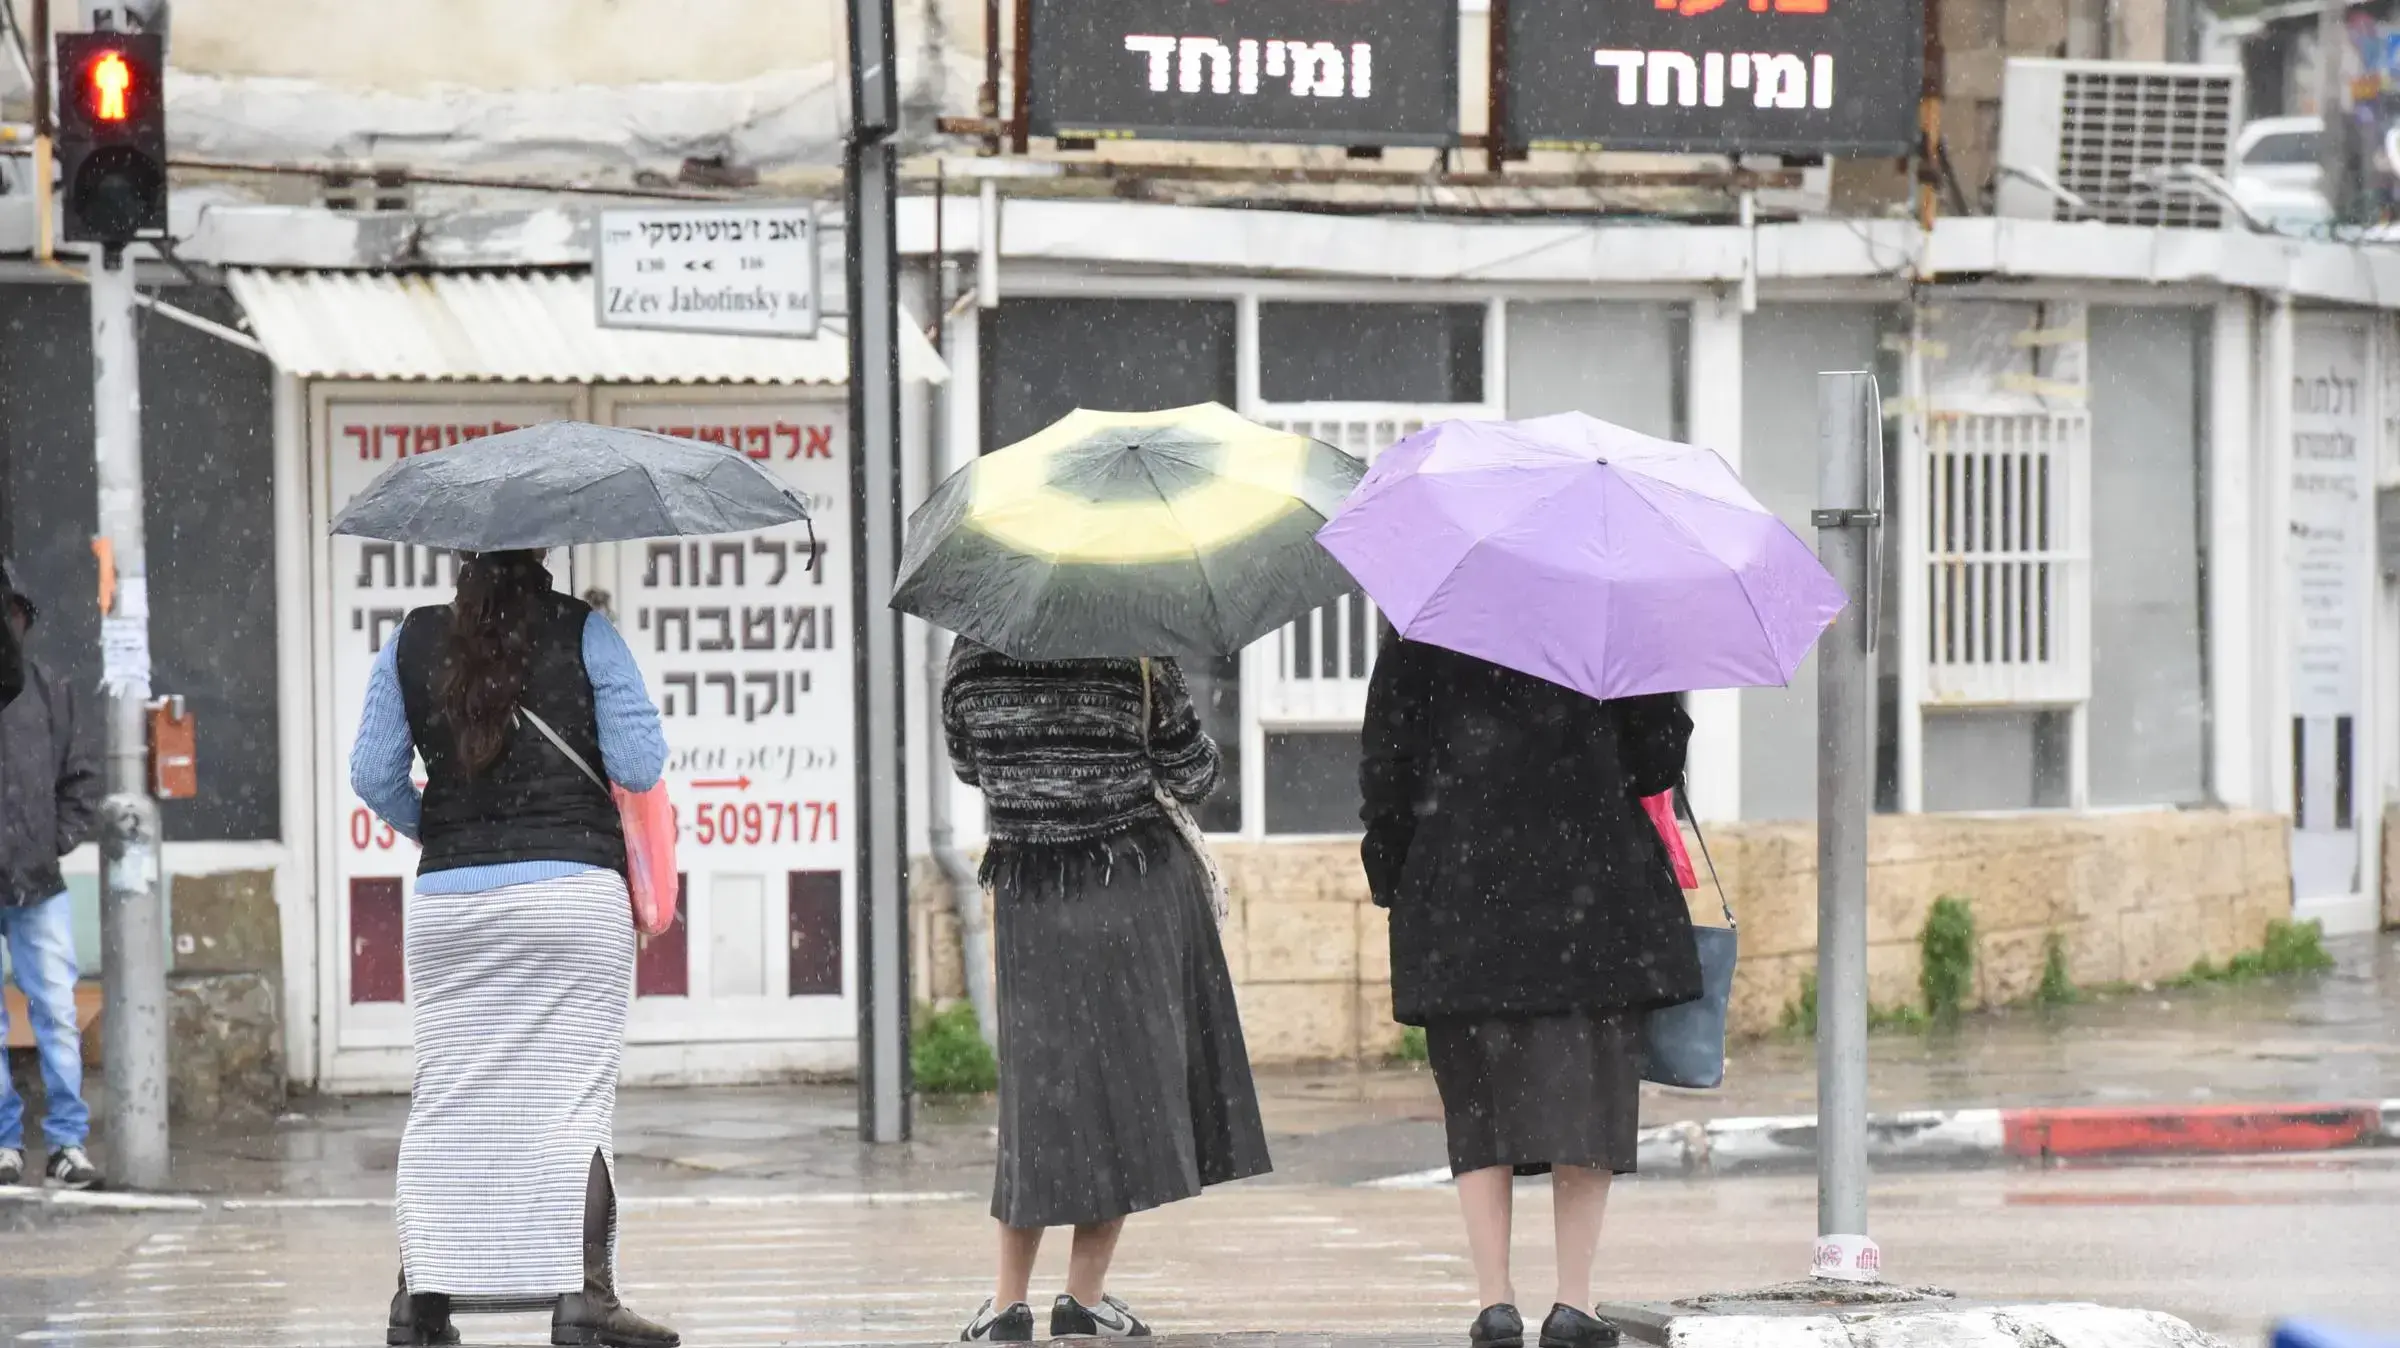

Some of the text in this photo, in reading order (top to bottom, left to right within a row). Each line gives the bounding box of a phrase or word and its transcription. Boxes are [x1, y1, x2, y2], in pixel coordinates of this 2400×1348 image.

[1124, 35, 1372, 98] ומיוחד
[1594, 49, 1834, 109] ומיוחד
[768, 218, 808, 240] זאב
[668, 284, 780, 319] Jabotinsky
[356, 541, 458, 588] תות
[643, 537, 827, 587] דלתות
[638, 604, 834, 652] ומטבחי
[663, 670, 811, 723] יוקרה
